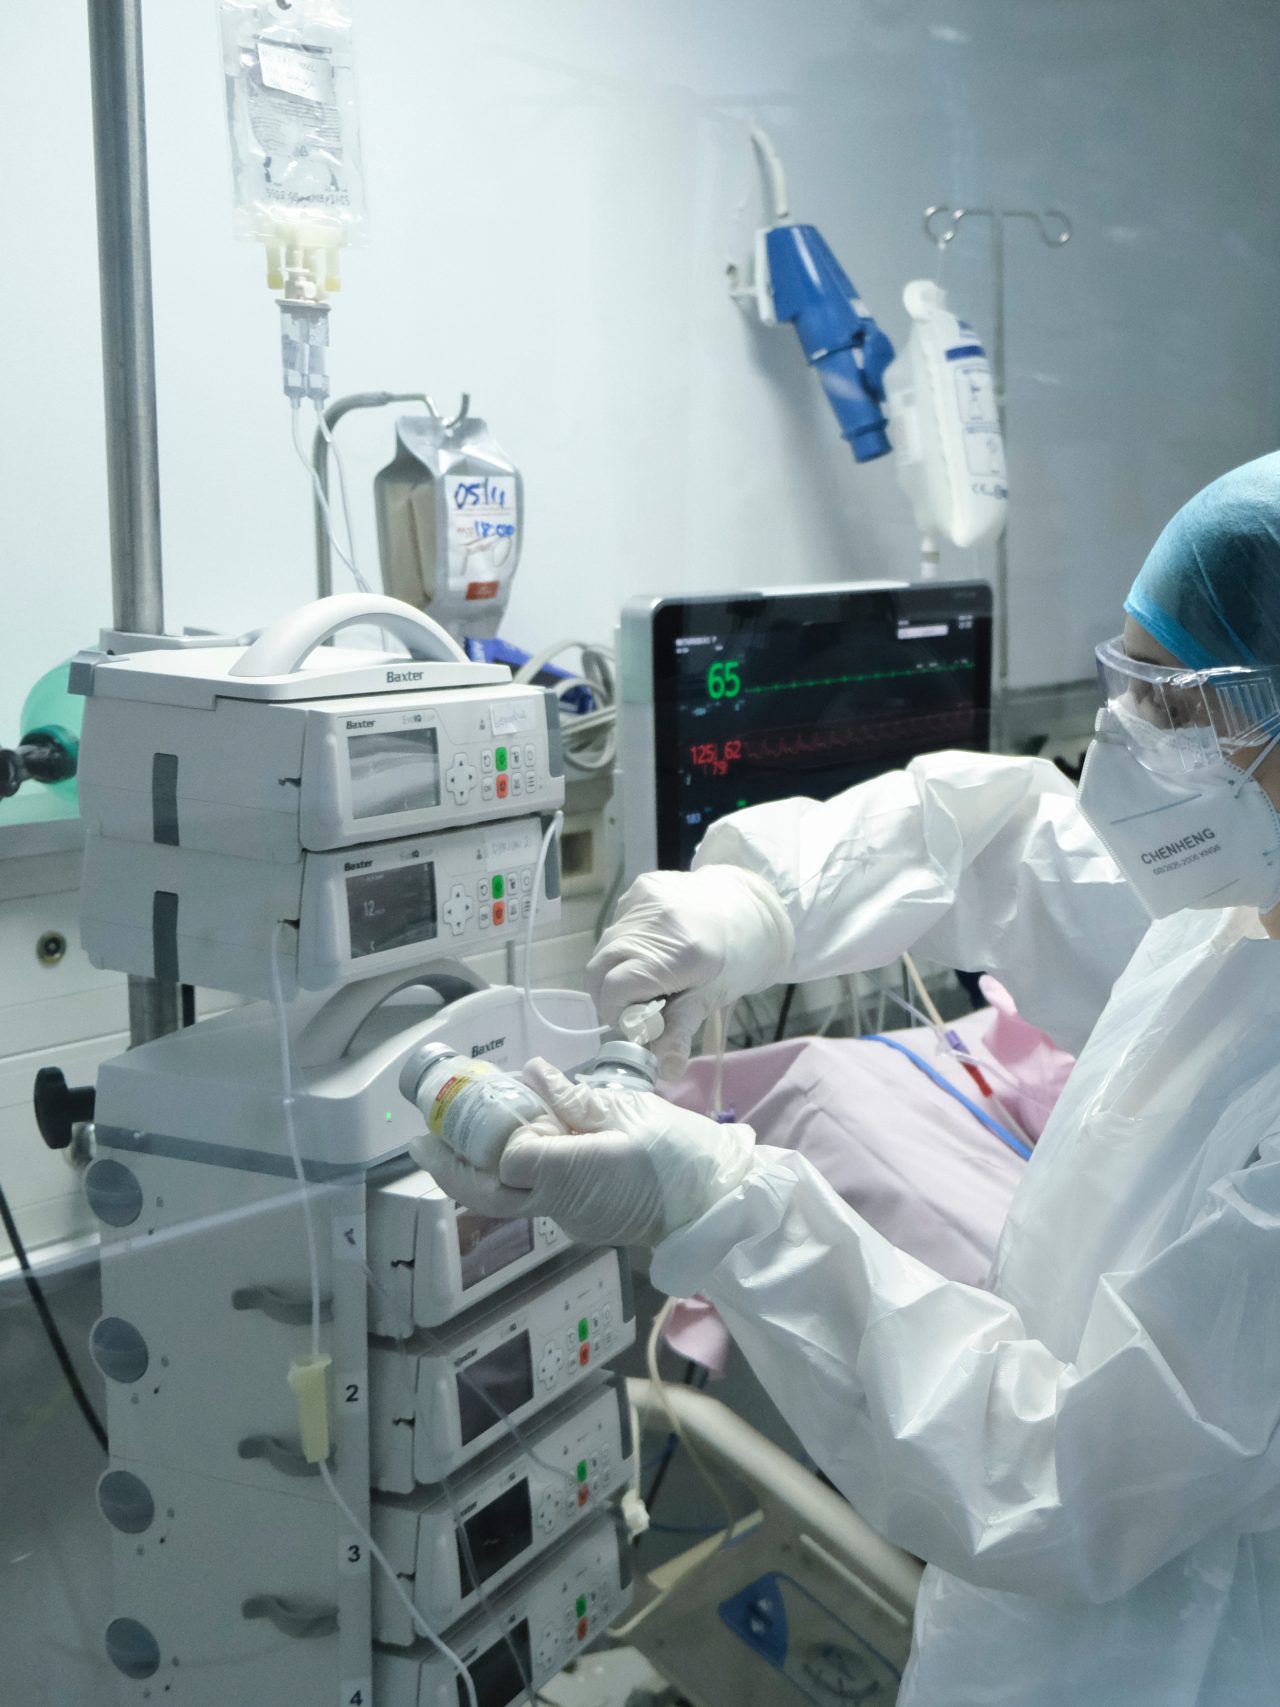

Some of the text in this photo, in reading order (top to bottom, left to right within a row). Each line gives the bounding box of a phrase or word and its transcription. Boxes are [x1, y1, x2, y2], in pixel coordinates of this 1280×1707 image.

[386, 671, 424, 683] Baxter
[708, 661, 741, 699] 65
[346, 720, 375, 730] Baxter
[690, 740, 742, 765] 125 62
[1141, 828, 1216, 865] CHENHENG
[344, 860, 373, 872] Baxter
[471, 1036, 506, 1058] Baxter
[346, 1384, 360, 1403] 2
[348, 1544, 361, 1563] 3
[350, 1690, 363, 1706] 4
